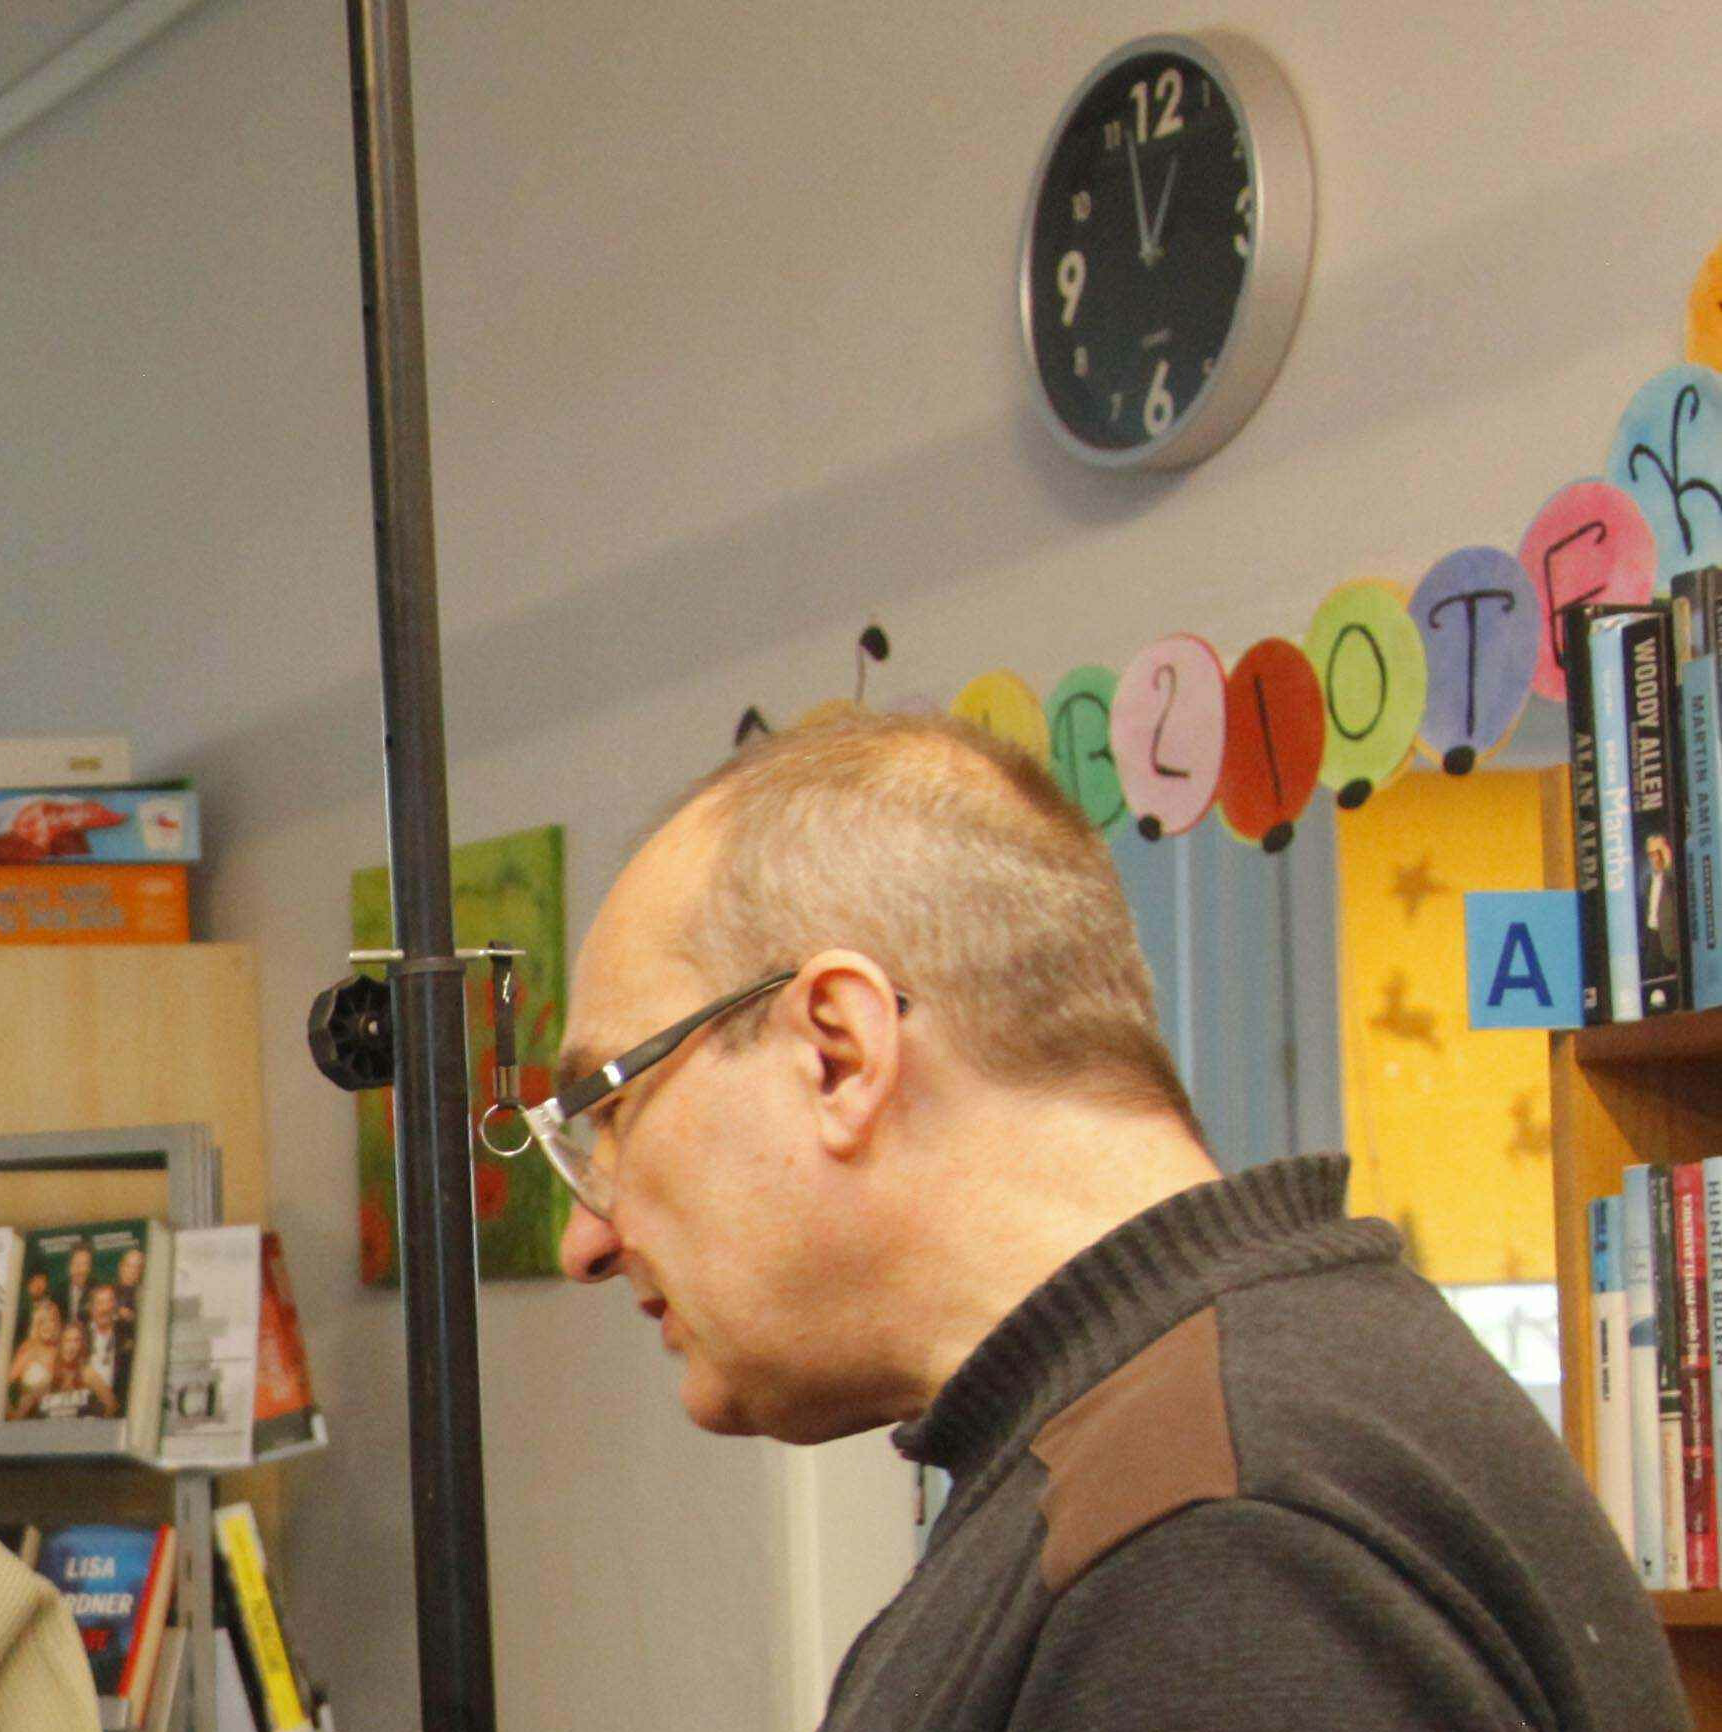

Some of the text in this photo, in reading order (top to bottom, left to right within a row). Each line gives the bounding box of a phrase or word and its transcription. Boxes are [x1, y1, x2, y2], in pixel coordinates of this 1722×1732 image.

[1130, 68, 1184, 143] 12
[1057, 250, 1087, 327] 9
[1143, 358, 1174, 437] 6
[1632, 638, 1663, 812] WOODY ALLEN
[1690, 694, 1708, 784] MARTIN
[1575, 731, 1600, 891] ALAN ALDA
[1605, 786, 1632, 891] Martha
[1696, 793, 1712, 847] AMIS
[1487, 921, 1554, 1007] A
[1707, 1180, 1722, 1280] HUNTER
[59, 1592, 135, 1617] RDNER
[64, 1556, 115, 1579] LISA
